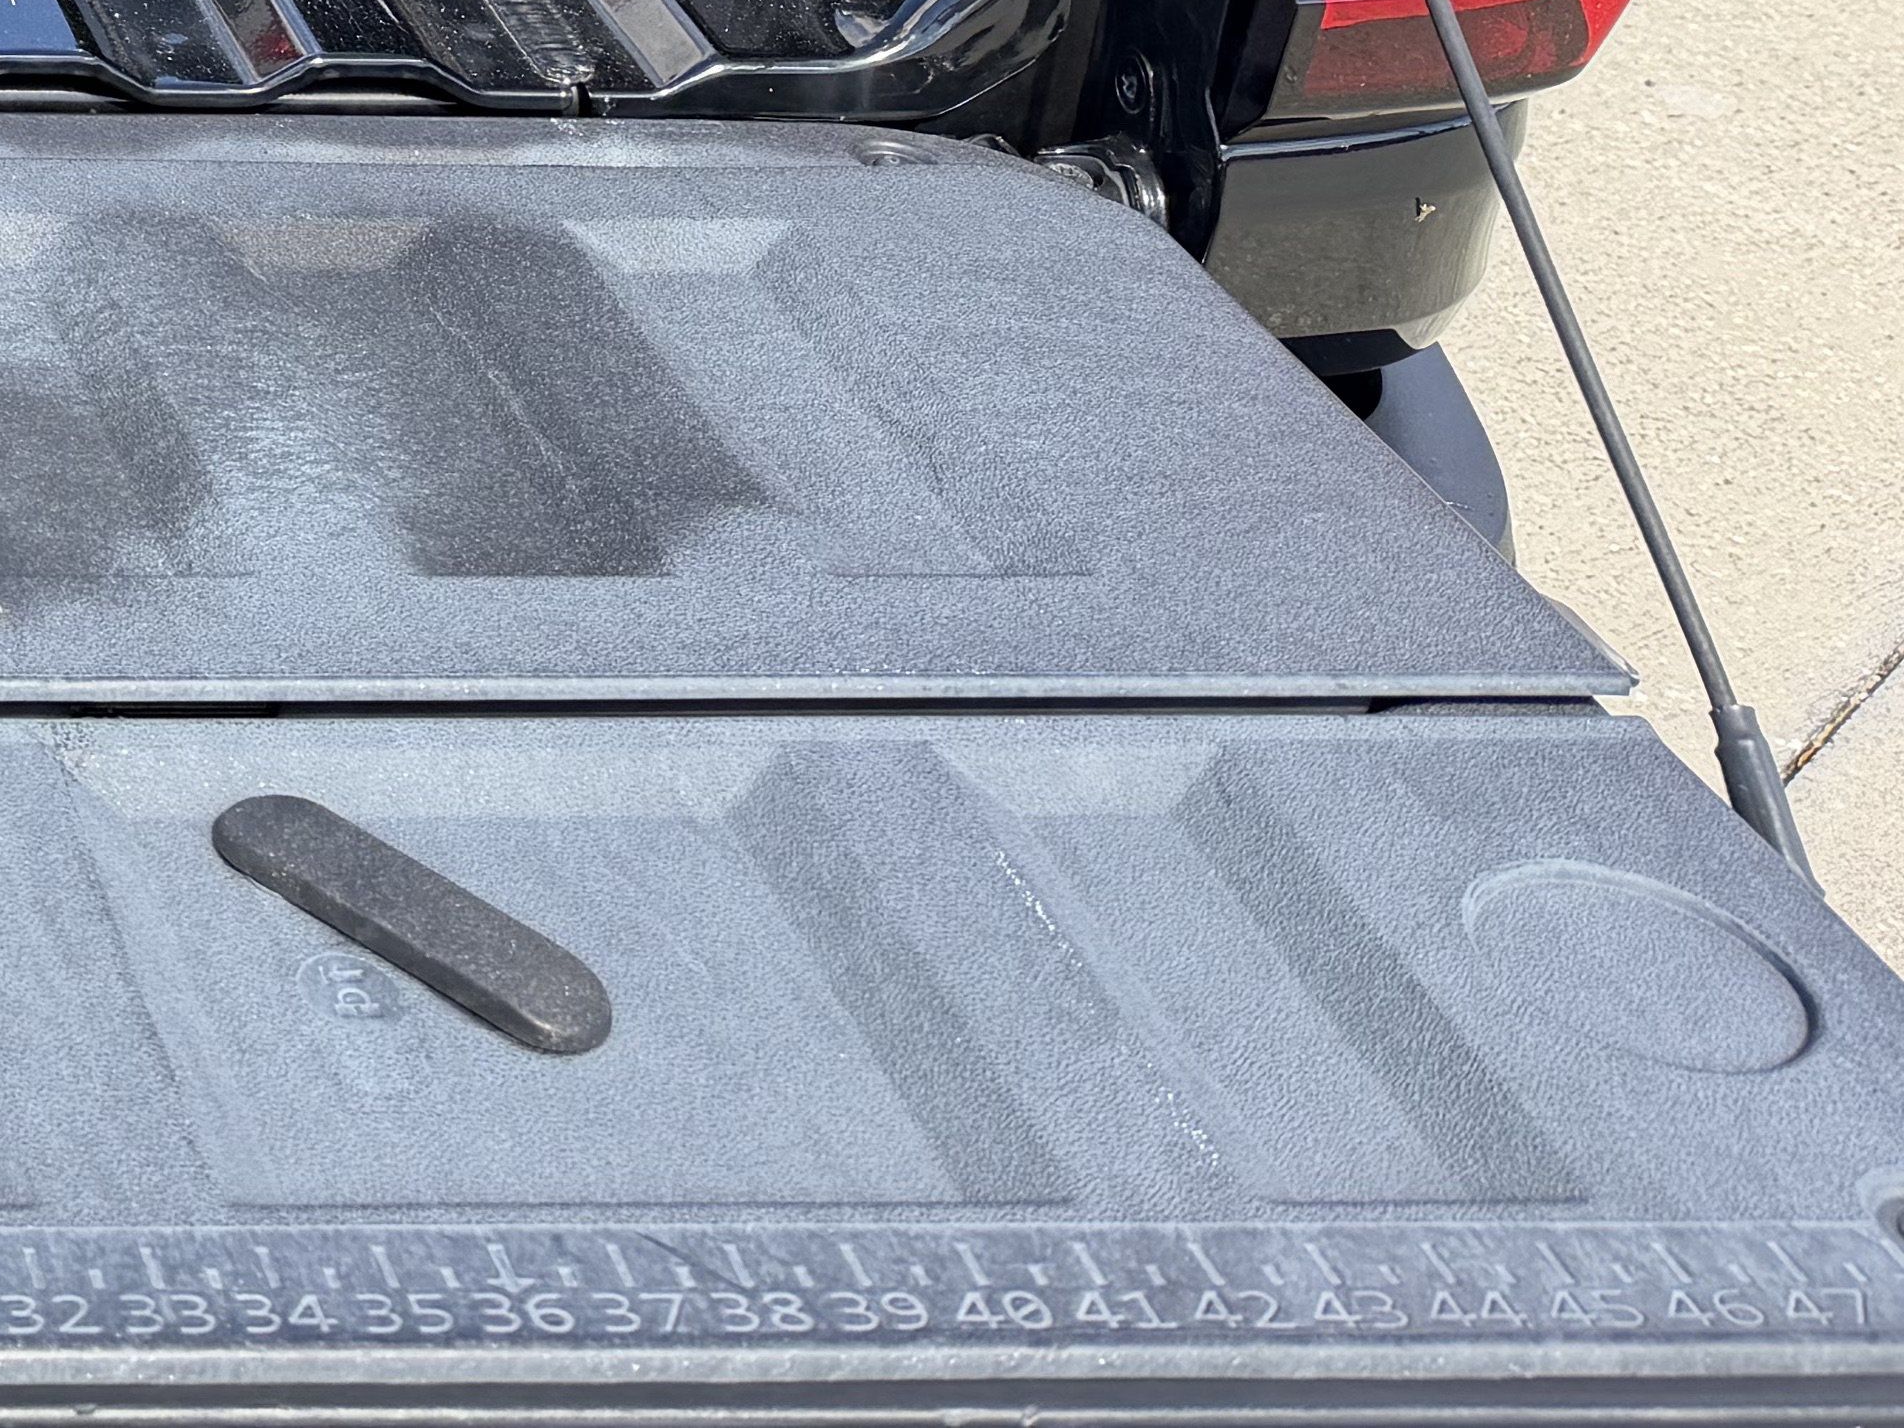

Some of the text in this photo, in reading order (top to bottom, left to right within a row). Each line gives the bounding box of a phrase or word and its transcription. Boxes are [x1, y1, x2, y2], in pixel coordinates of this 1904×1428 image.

[1, 1294, 103, 1333] 32
[120, 1294, 218, 1333] 33
[240, 1293, 339, 1332] 34
[357, 1293, 456, 1332] 35
[474, 1293, 576, 1332] 36
[593, 1292, 686, 1331] 37
[712, 1292, 816, 1331] 38
[829, 1292, 930, 1331] 39
[957, 1291, 1053, 1330] 40
[1076, 1291, 1179, 1330] 41
[1193, 1291, 1297, 1329] 42
[1313, 1290, 1408, 1329] 43
[1431, 1290, 1535, 1328] 44
[1549, 1290, 1648, 1328] 45
[1667, 1289, 1763, 1327] 46
[1785, 1289, 1867, 1327] 47
